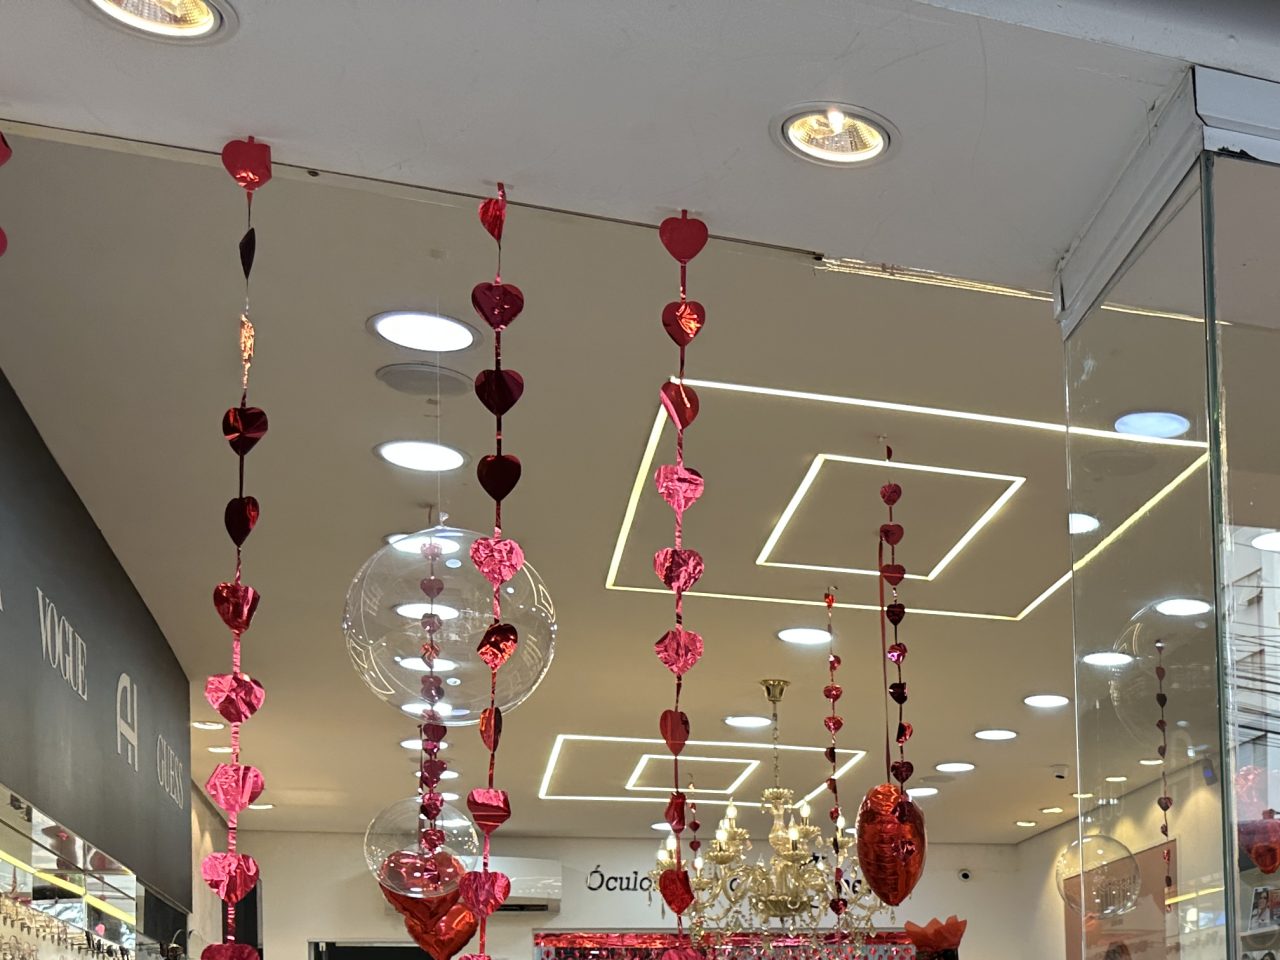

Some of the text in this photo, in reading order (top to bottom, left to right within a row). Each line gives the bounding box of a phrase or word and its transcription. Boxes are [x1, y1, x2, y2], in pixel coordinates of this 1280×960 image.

[36, 586, 87, 701] VOGUE
[156, 733, 184, 810] GUESS
[586, 865, 656, 892] Óculo
